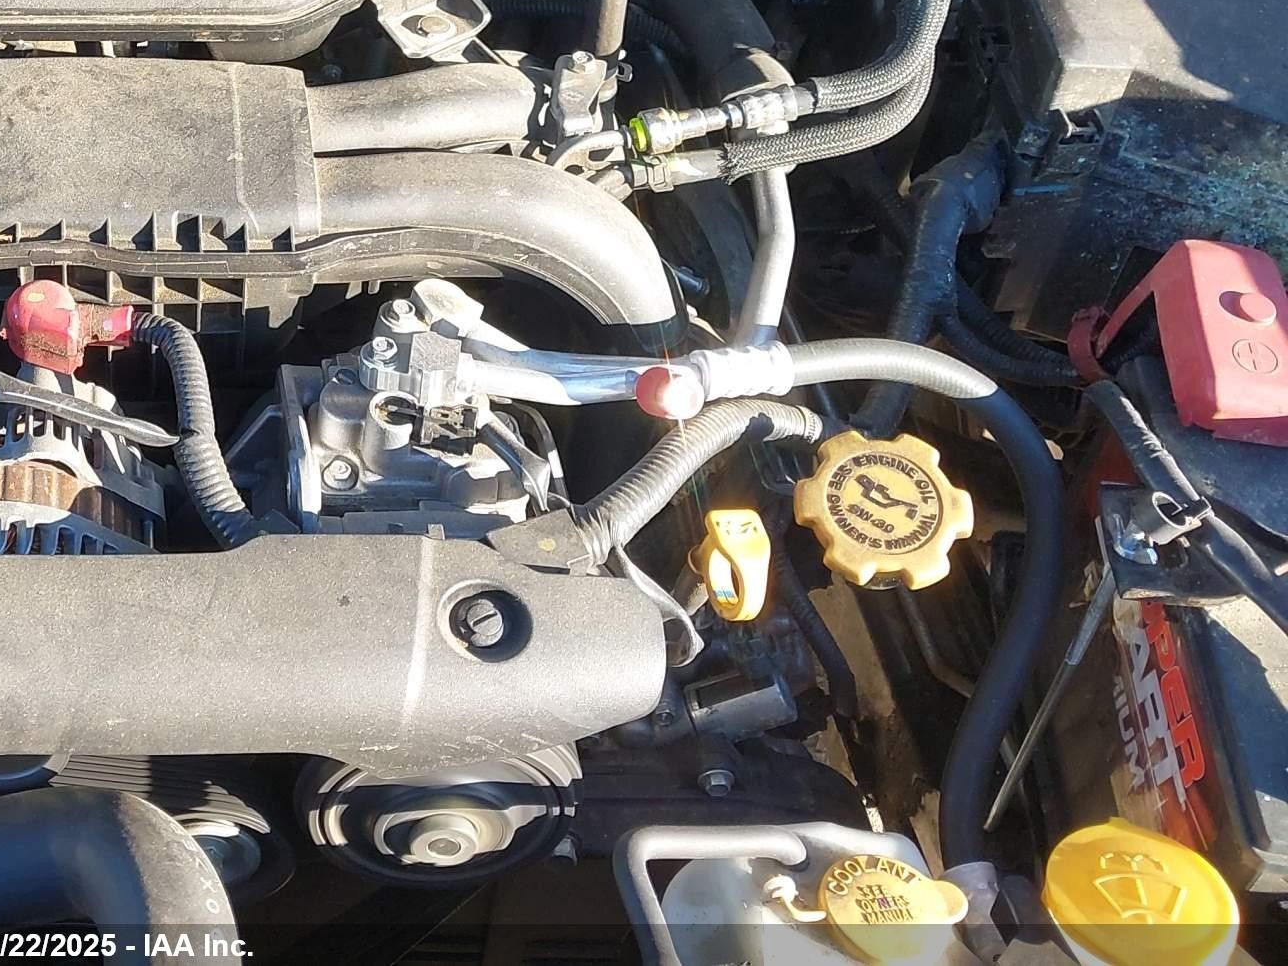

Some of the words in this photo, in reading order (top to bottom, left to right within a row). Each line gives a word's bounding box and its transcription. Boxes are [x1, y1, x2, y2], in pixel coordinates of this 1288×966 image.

[827, 464, 853, 492] SEE
[853, 454, 919, 480] ENGINE
[914, 477, 937, 505] OIL
[826, 494, 883, 550] OWNER'S
[884, 513, 938, 551] MANUAL
[826, 855, 919, 897] COOLANT
[861, 908, 915, 925] MANUA
